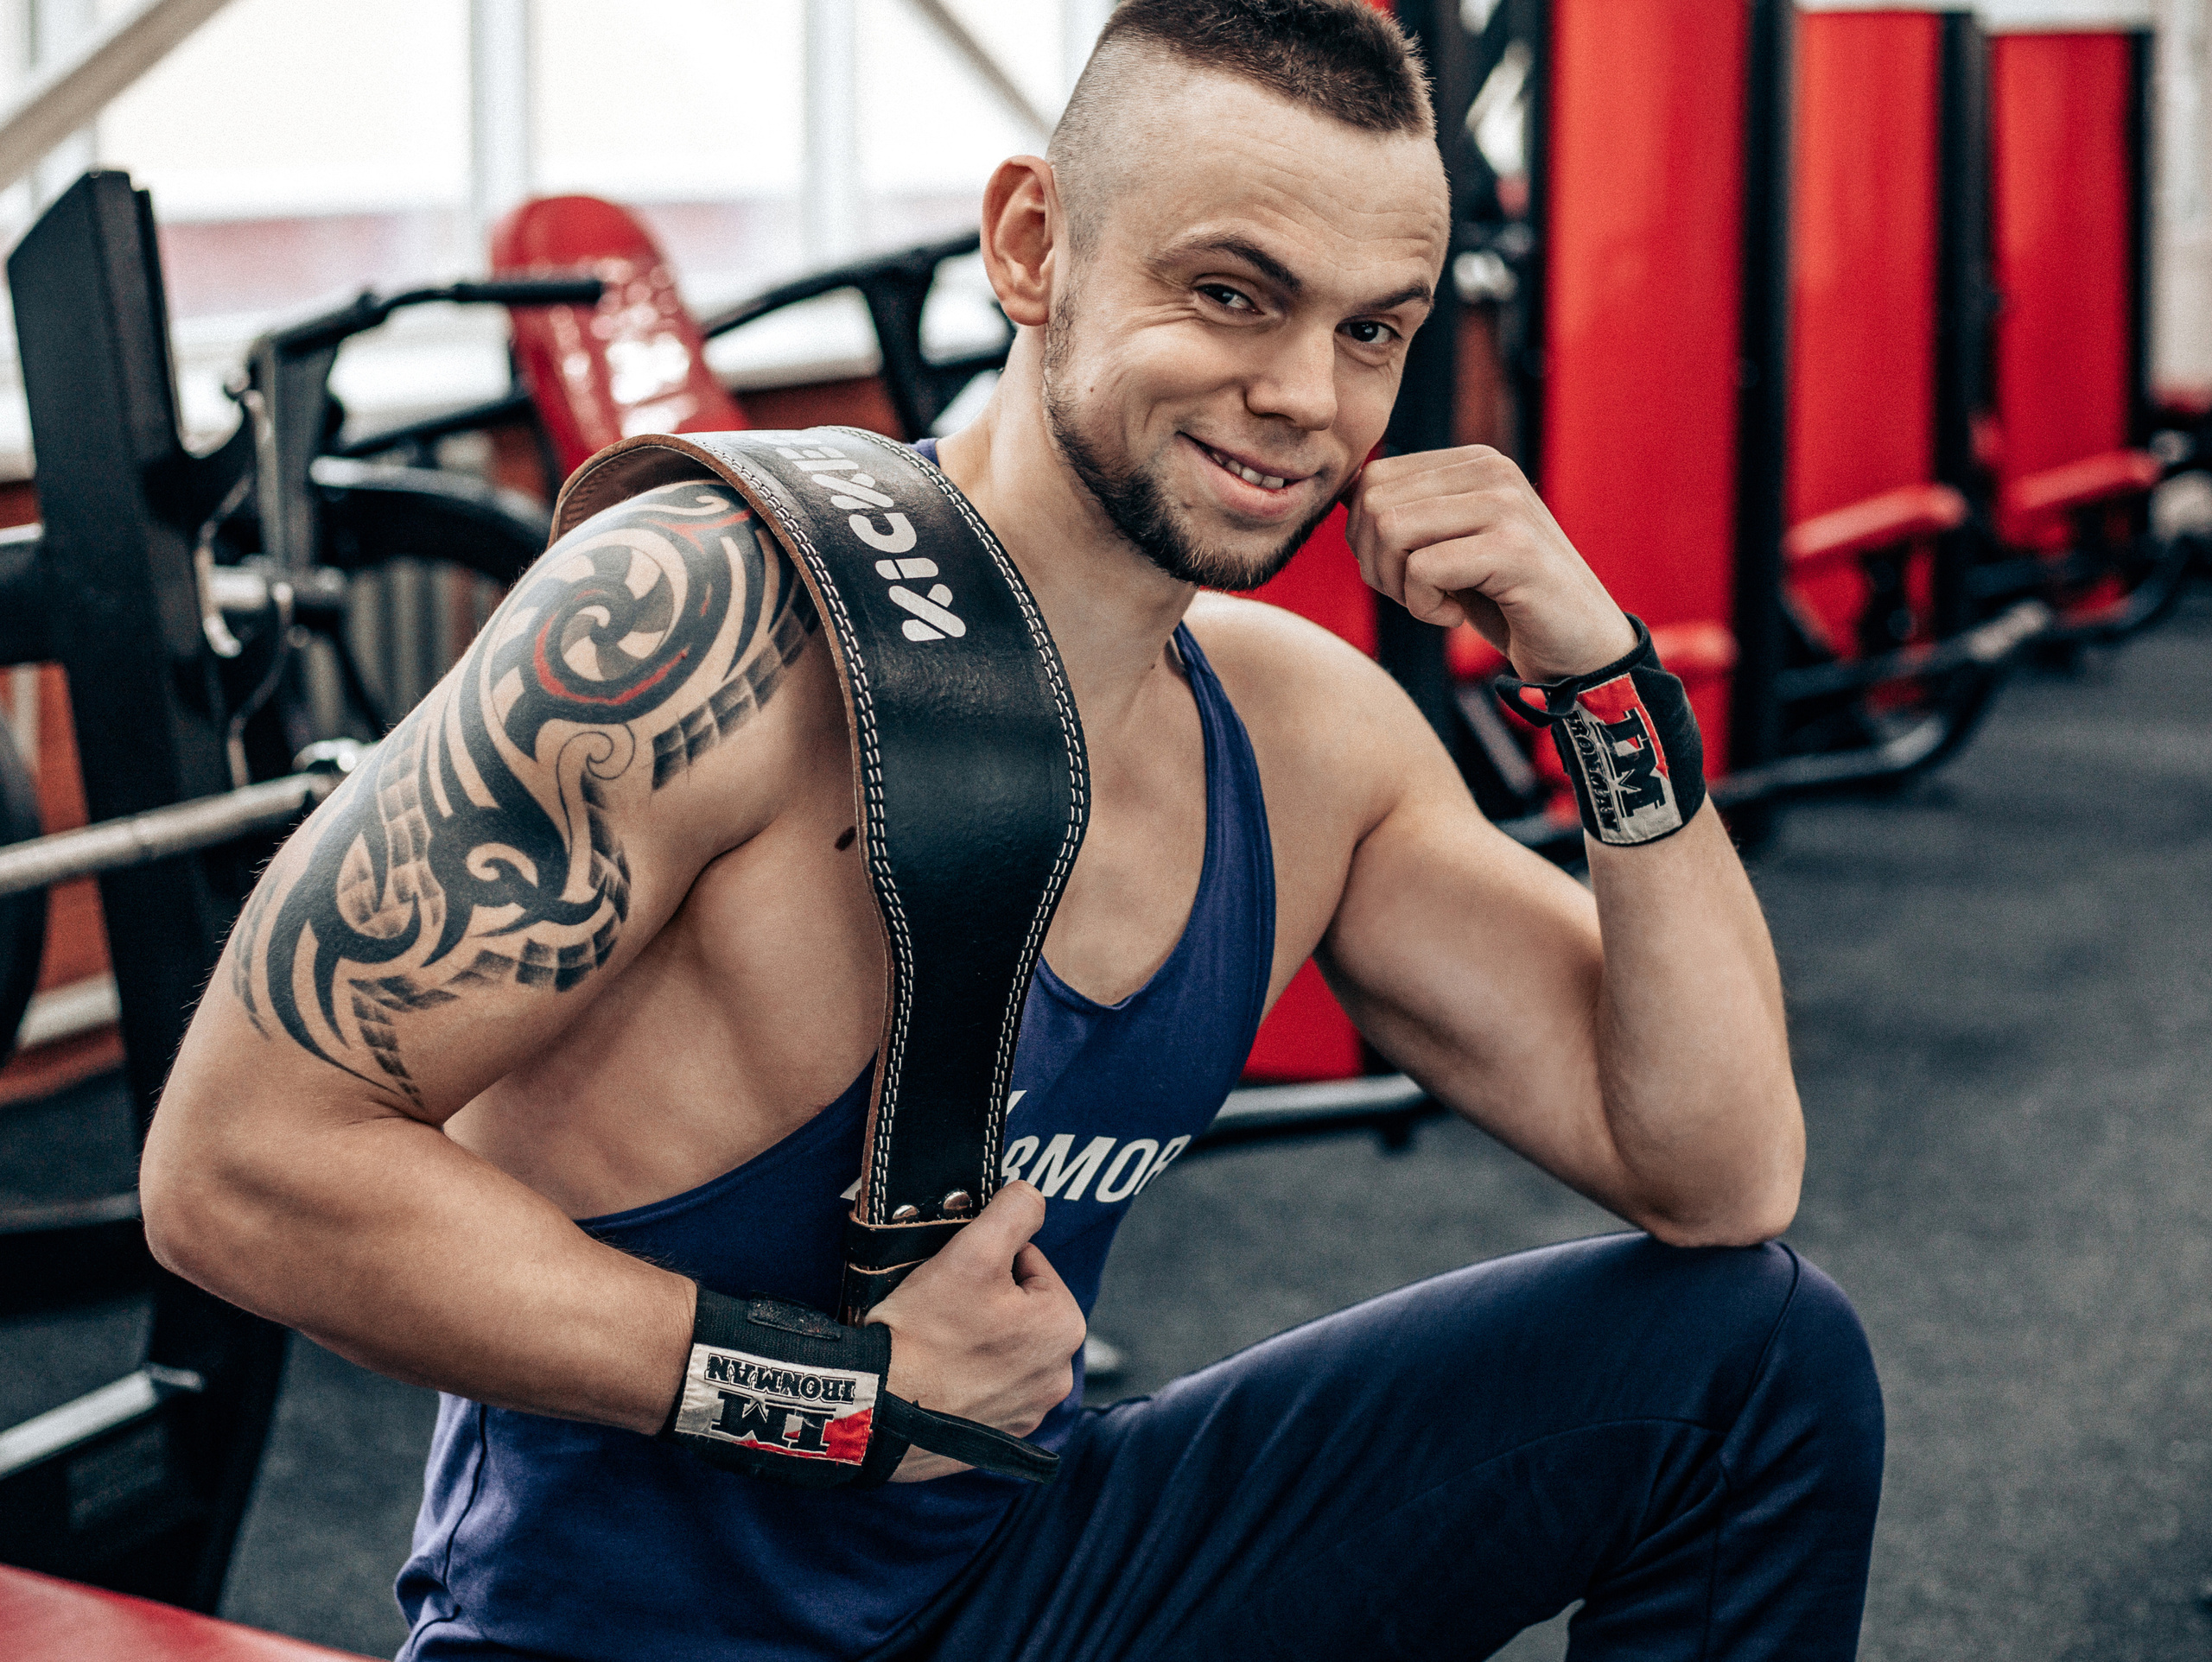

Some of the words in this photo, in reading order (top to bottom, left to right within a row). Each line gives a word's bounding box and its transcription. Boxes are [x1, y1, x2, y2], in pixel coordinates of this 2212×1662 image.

[750, 435, 967, 642] KICKE
[995, 1133, 1192, 1202] RMOR
[705, 1354, 857, 1405] IRONMAN
[711, 1392, 835, 1453] IM
